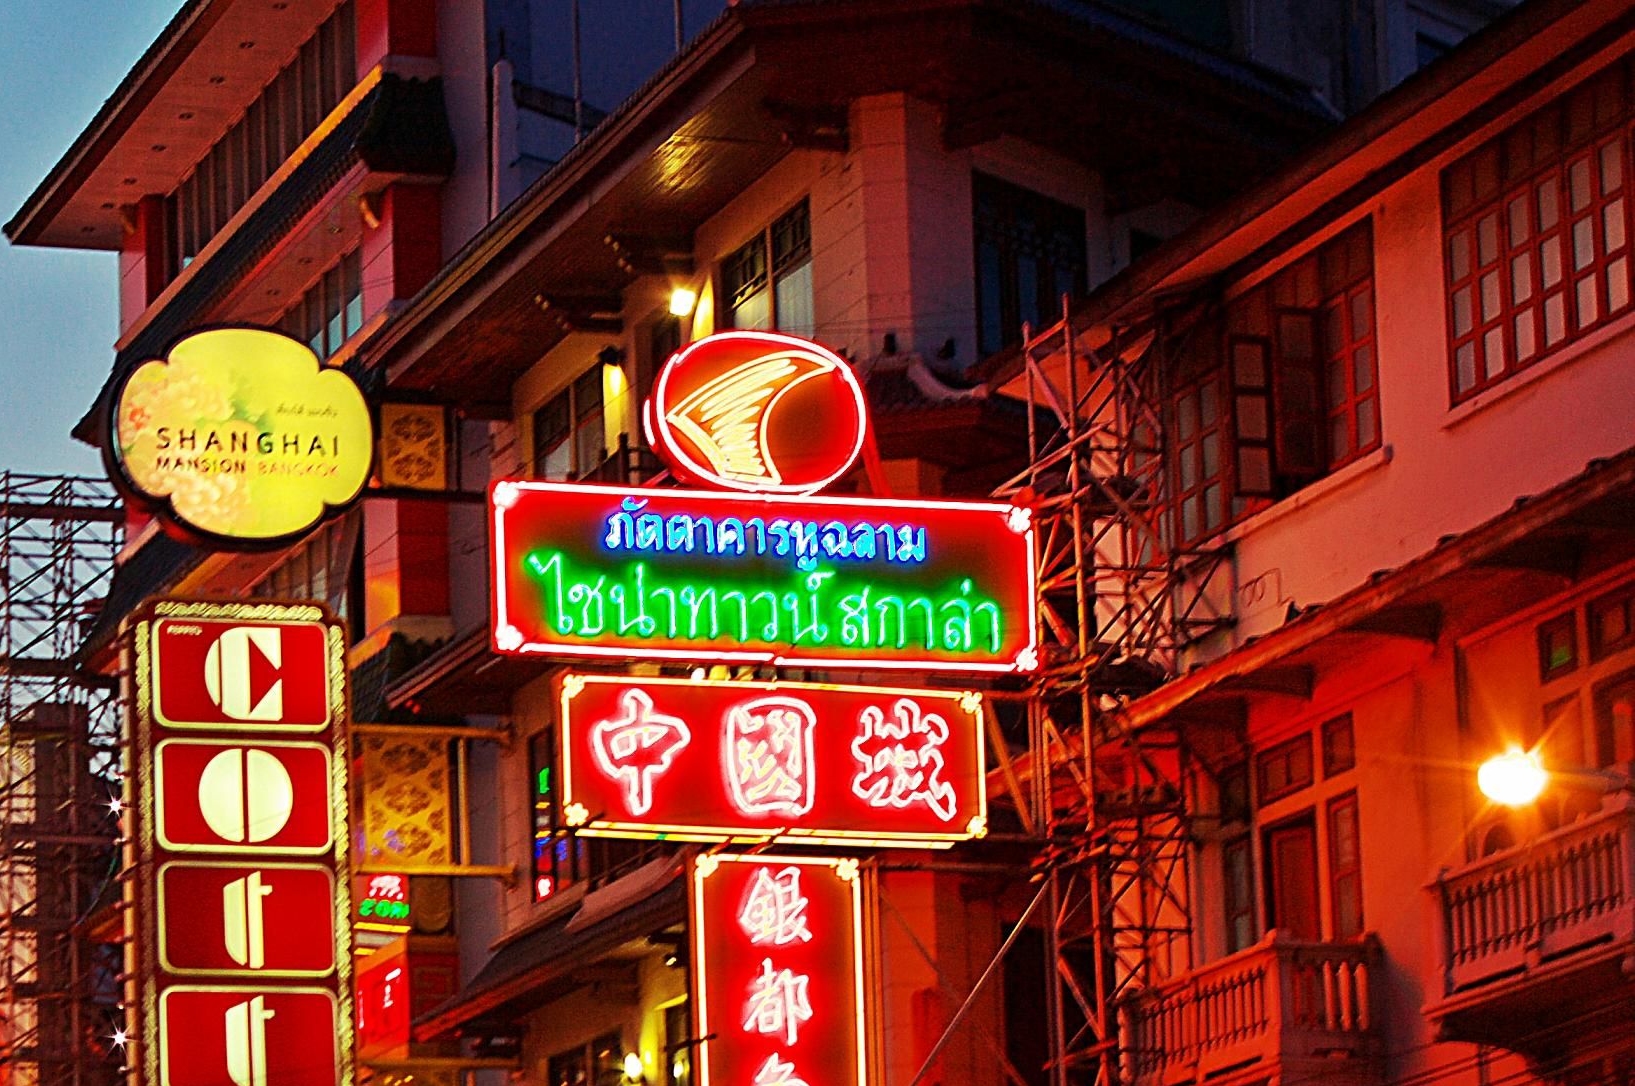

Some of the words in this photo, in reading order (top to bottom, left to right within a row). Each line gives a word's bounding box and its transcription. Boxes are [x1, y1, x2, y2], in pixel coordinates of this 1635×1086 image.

[156, 427, 339, 458] SHANGHAI
[156, 456, 247, 474] MANSION
[257, 461, 339, 477] BANGKOK
